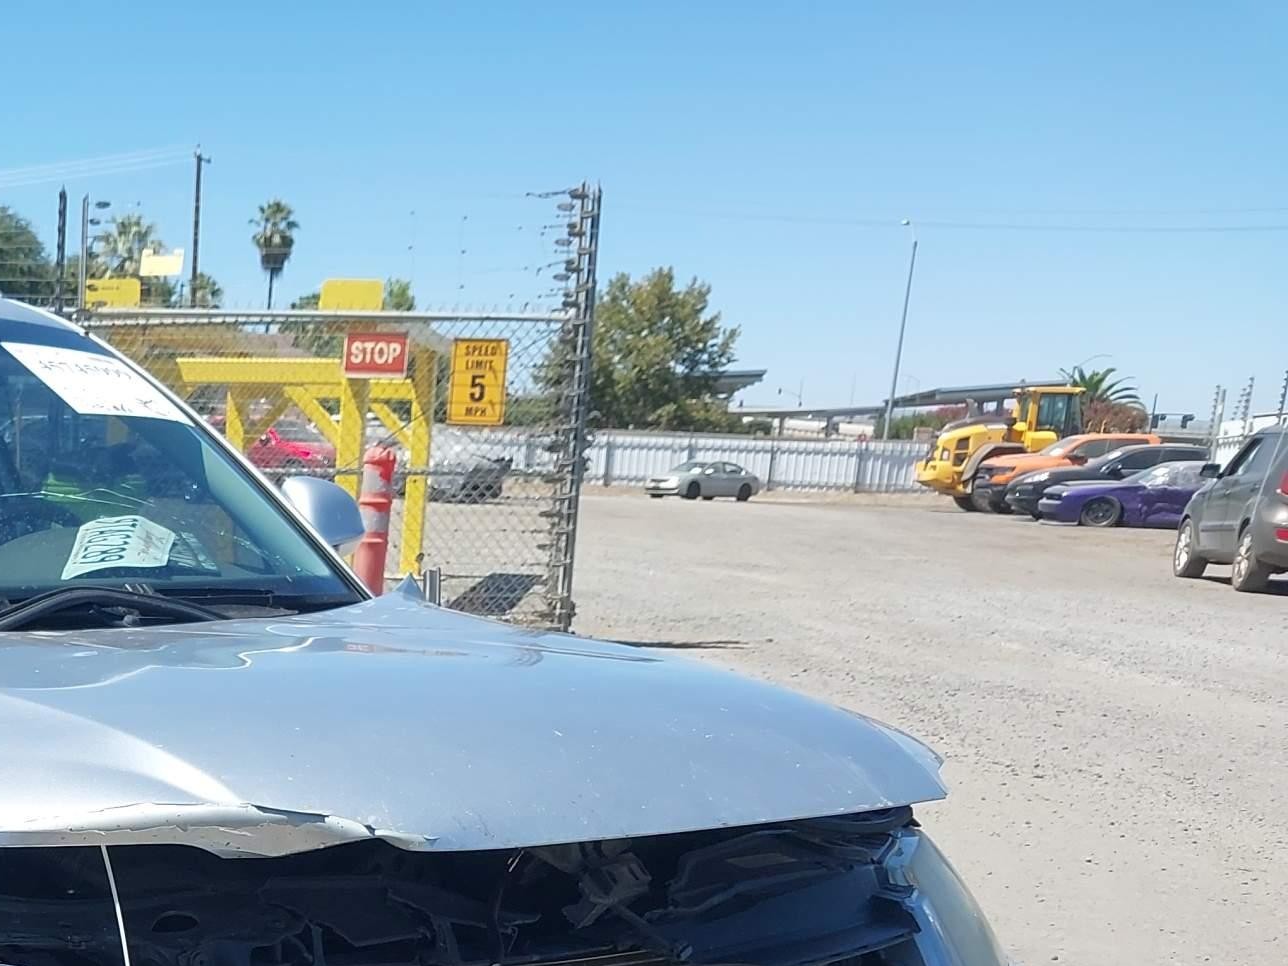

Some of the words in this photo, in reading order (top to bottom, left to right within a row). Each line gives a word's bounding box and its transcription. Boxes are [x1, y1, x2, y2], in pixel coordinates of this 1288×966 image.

[350, 341, 402, 364] STOP
[464, 344, 497, 357] SPEED
[465, 359, 494, 370] LIMIT
[469, 374, 486, 403] 5
[464, 406, 487, 417] MPH
